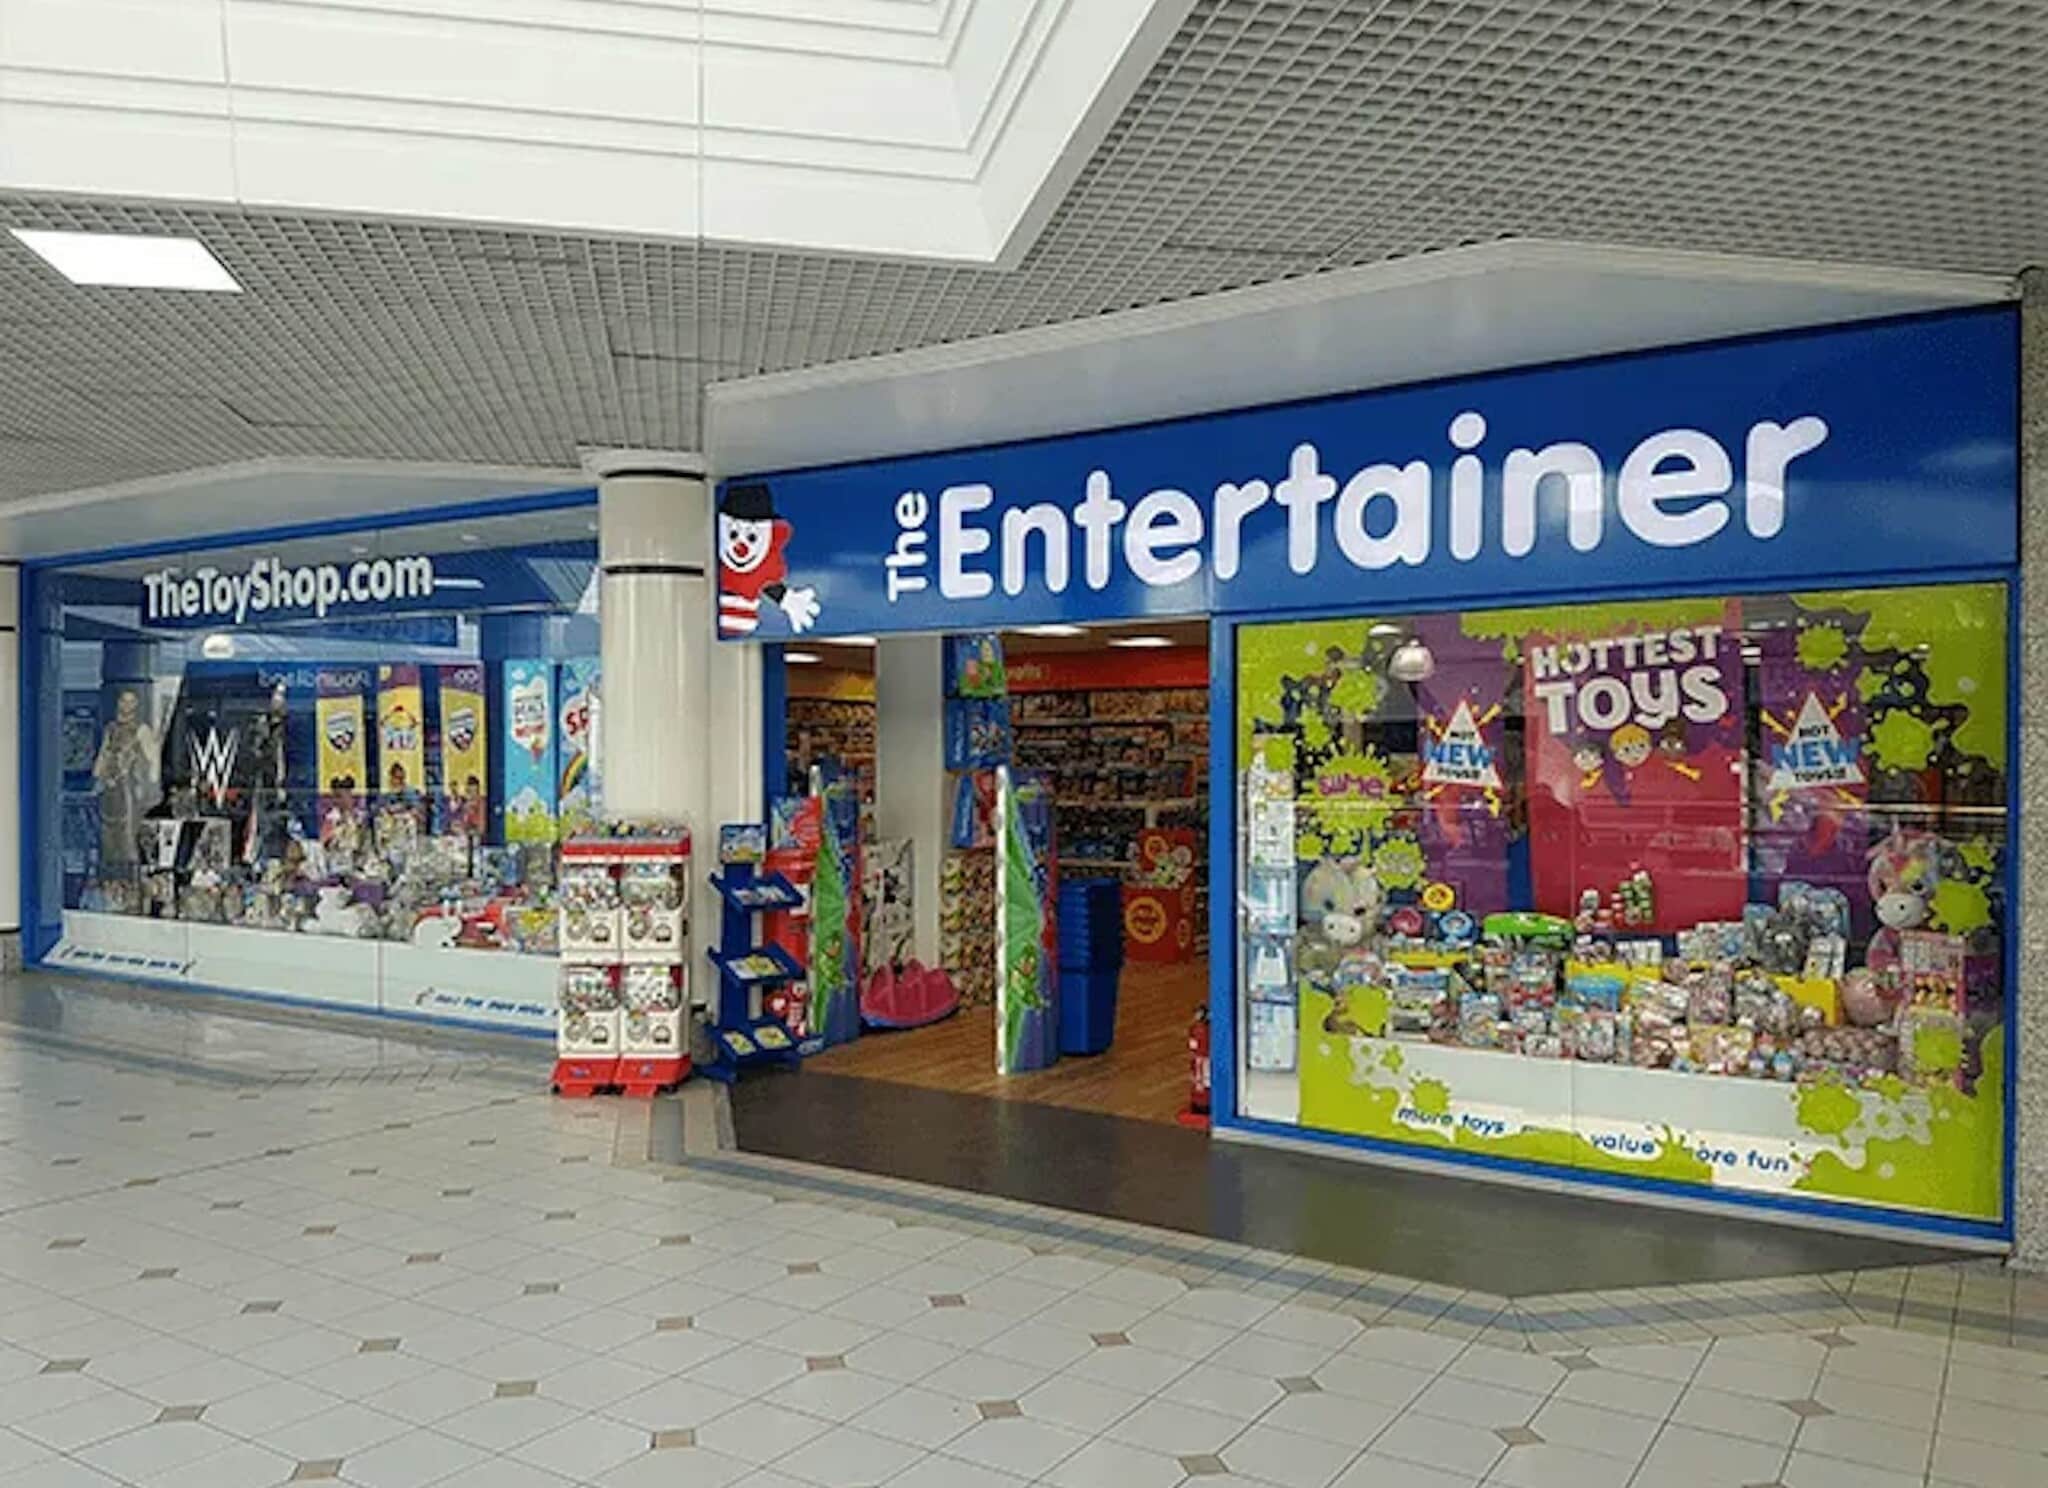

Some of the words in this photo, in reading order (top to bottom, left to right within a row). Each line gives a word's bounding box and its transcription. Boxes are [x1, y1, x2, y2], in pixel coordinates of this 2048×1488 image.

[885, 490, 928, 604] The
[938, 412, 1828, 601] Entertainer
[143, 556, 434, 625] TheToyShop.com
[1530, 625, 1724, 679] HOTTEST
[1533, 665, 1729, 736] TOYS
[1422, 738, 1497, 769] NEW
[1771, 738, 1860, 769] NEW
[1398, 1106, 1454, 1126] more
[1461, 1112, 1505, 1135] toys
[1590, 1133, 1657, 1155] value
[1696, 1147, 1738, 1167] ore
[1746, 1149, 1790, 1173] fun
